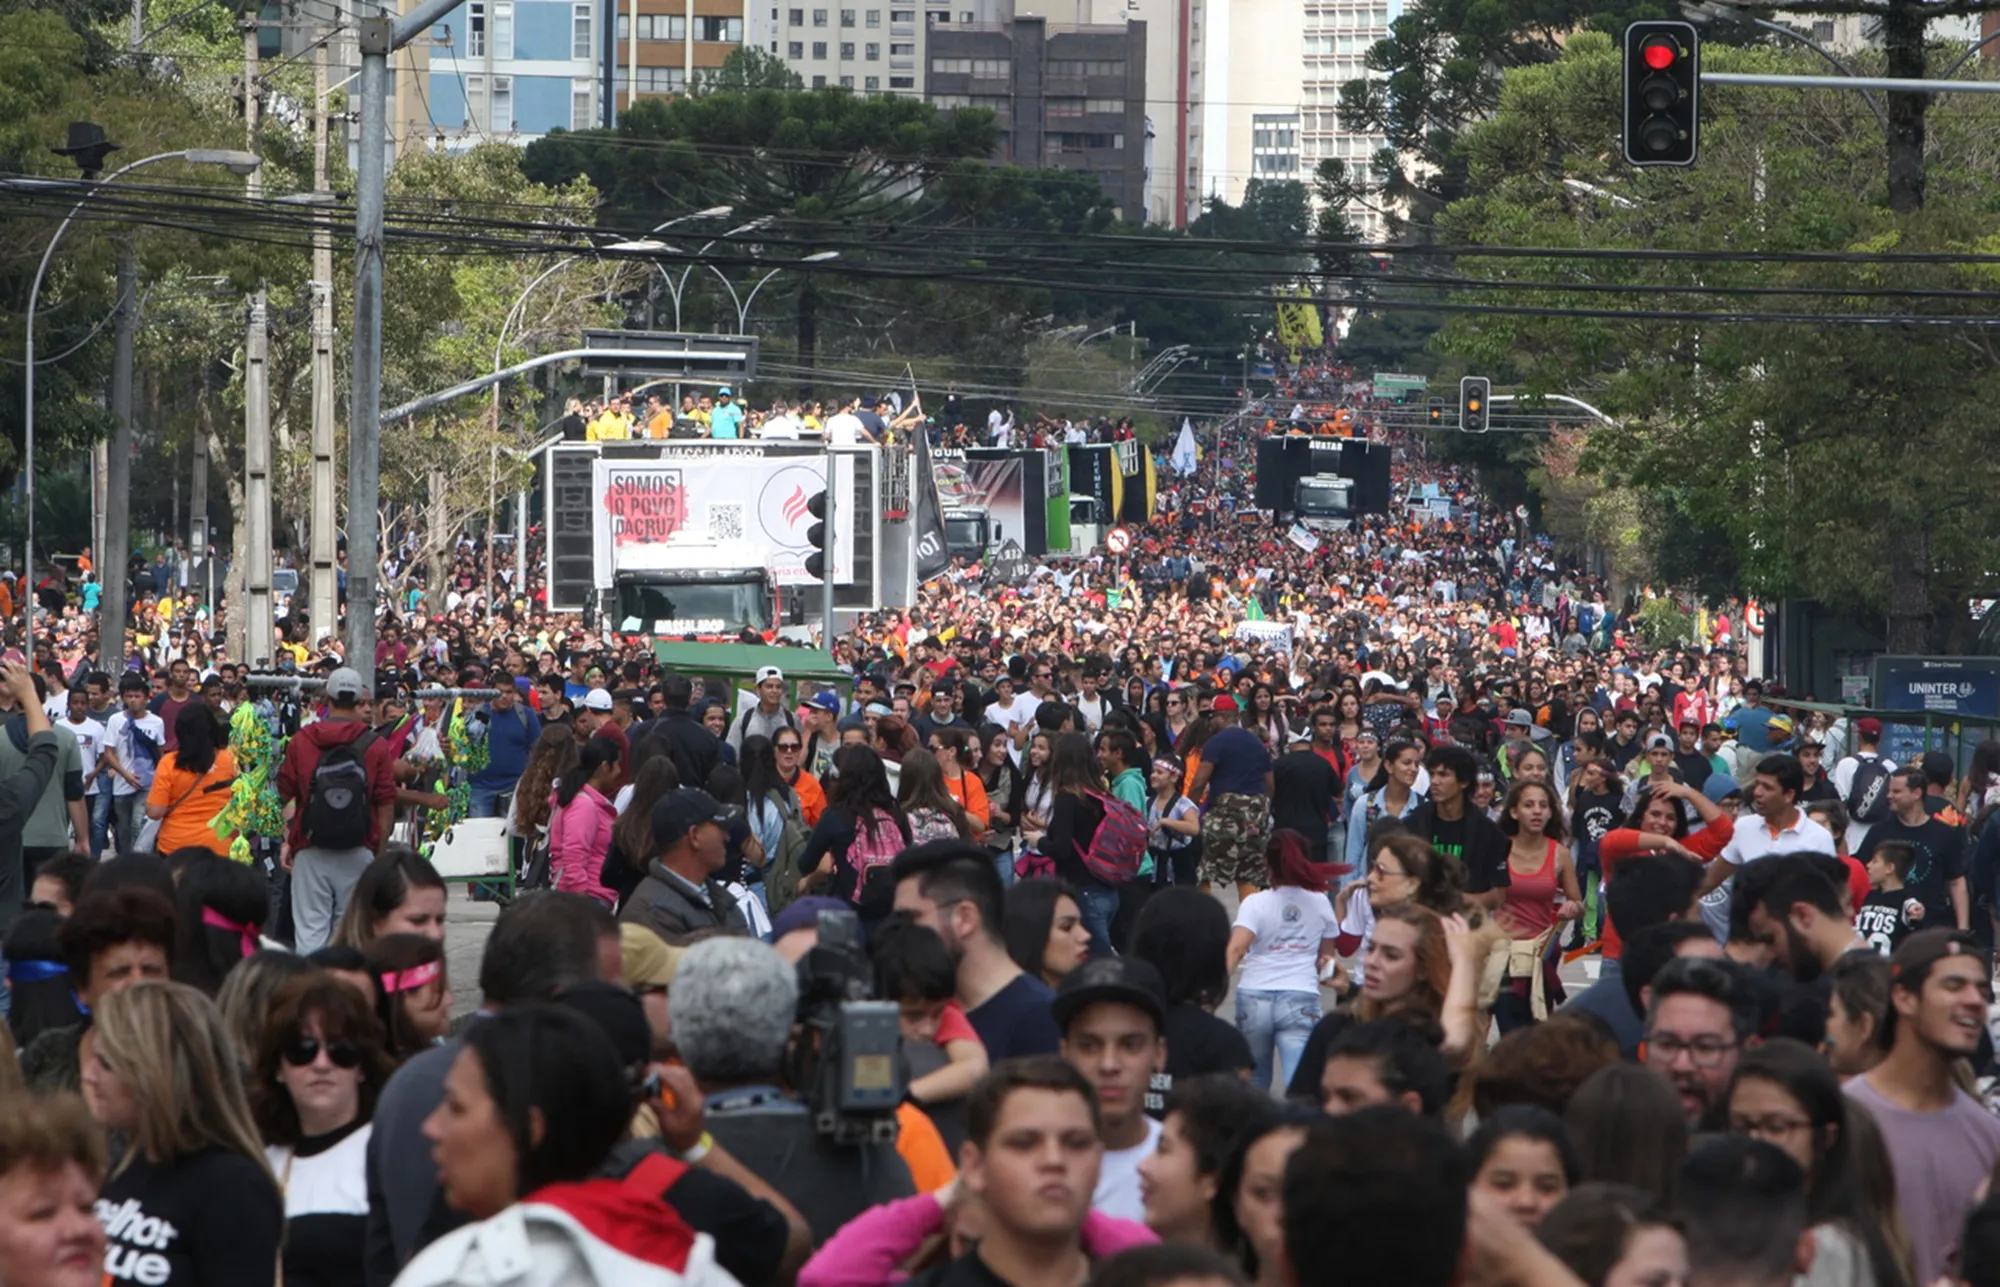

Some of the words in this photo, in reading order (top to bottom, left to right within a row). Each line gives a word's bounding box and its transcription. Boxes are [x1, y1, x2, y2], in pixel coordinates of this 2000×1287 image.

[1308, 440, 1344, 452] AVATAR
[614, 475, 676, 496] SOMOS
[614, 497, 625, 516] O
[631, 497, 676, 516] POVO
[1909, 682, 1957, 694] UNINTER
[1856, 775, 1885, 818] adidas
[1144, 1093, 1165, 1110] TES
